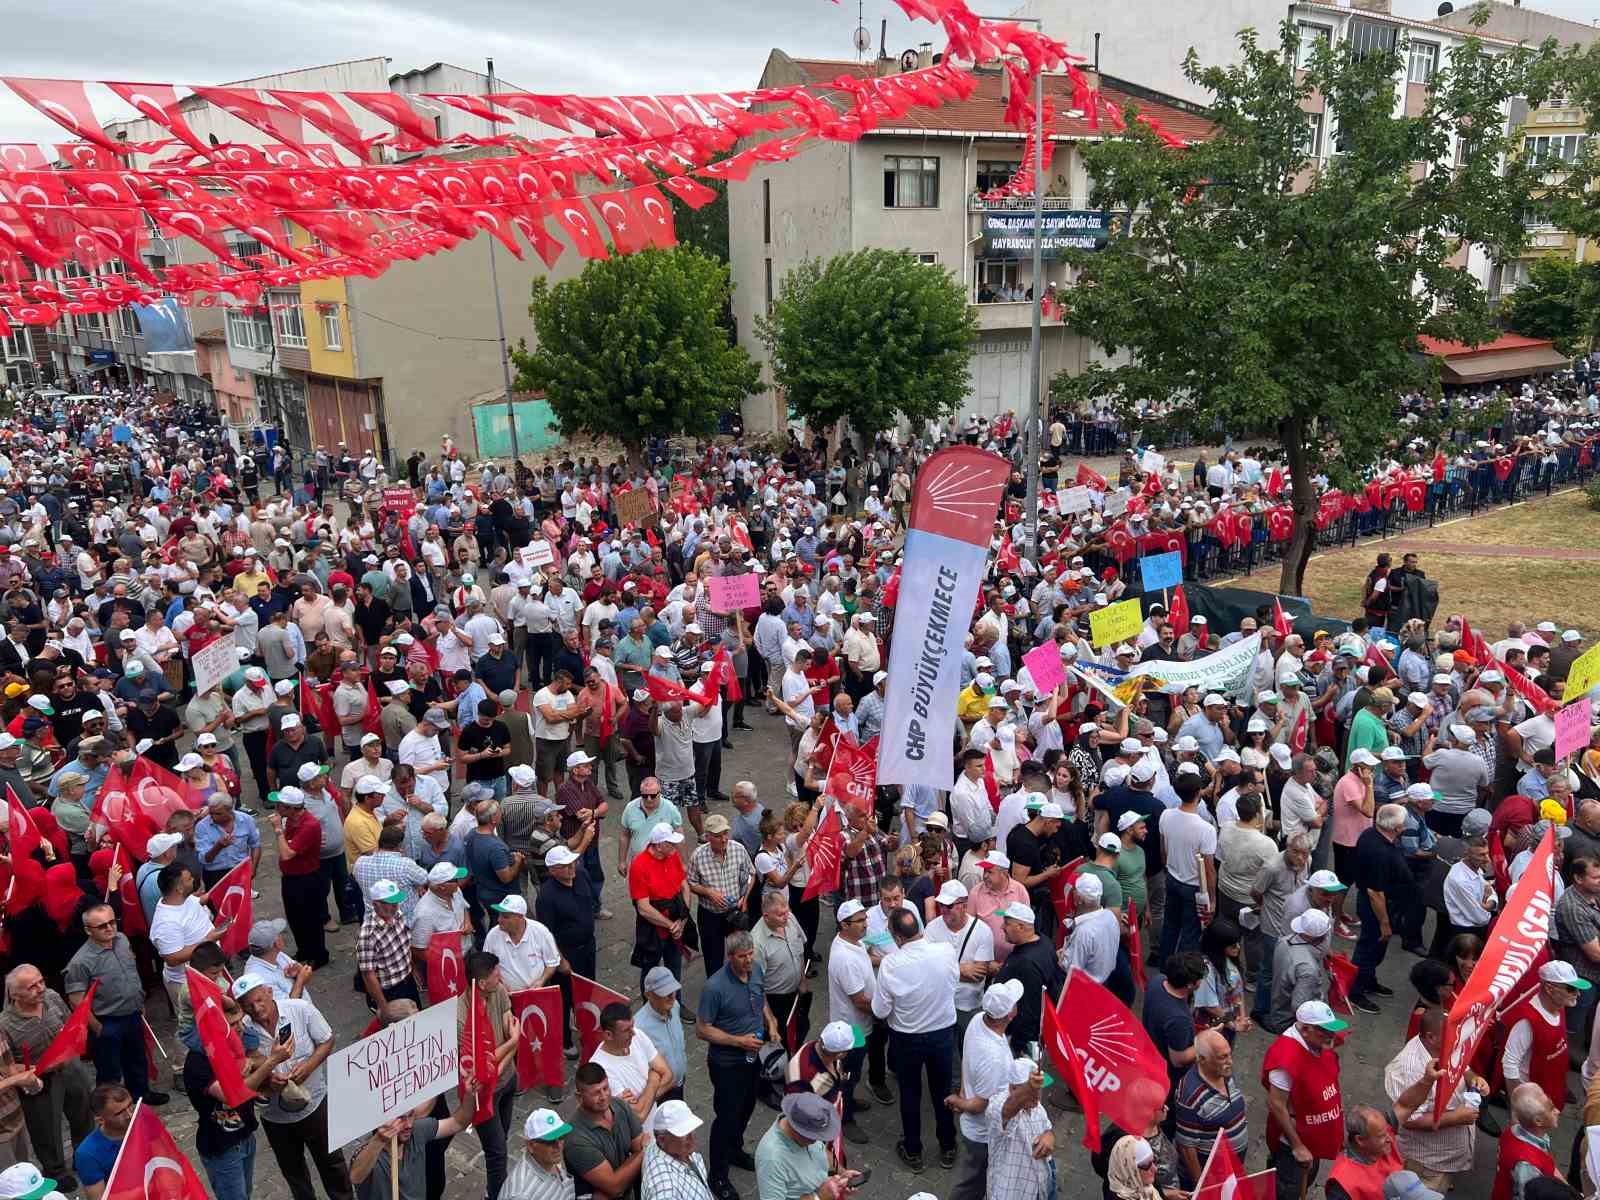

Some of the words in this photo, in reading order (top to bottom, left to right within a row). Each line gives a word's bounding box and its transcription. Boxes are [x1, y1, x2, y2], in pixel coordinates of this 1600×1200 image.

[911, 565, 959, 721] BÜYÜKÇEKMECE
[905, 719, 929, 761] CHP
[1322, 1083, 1338, 1101] DİSK
